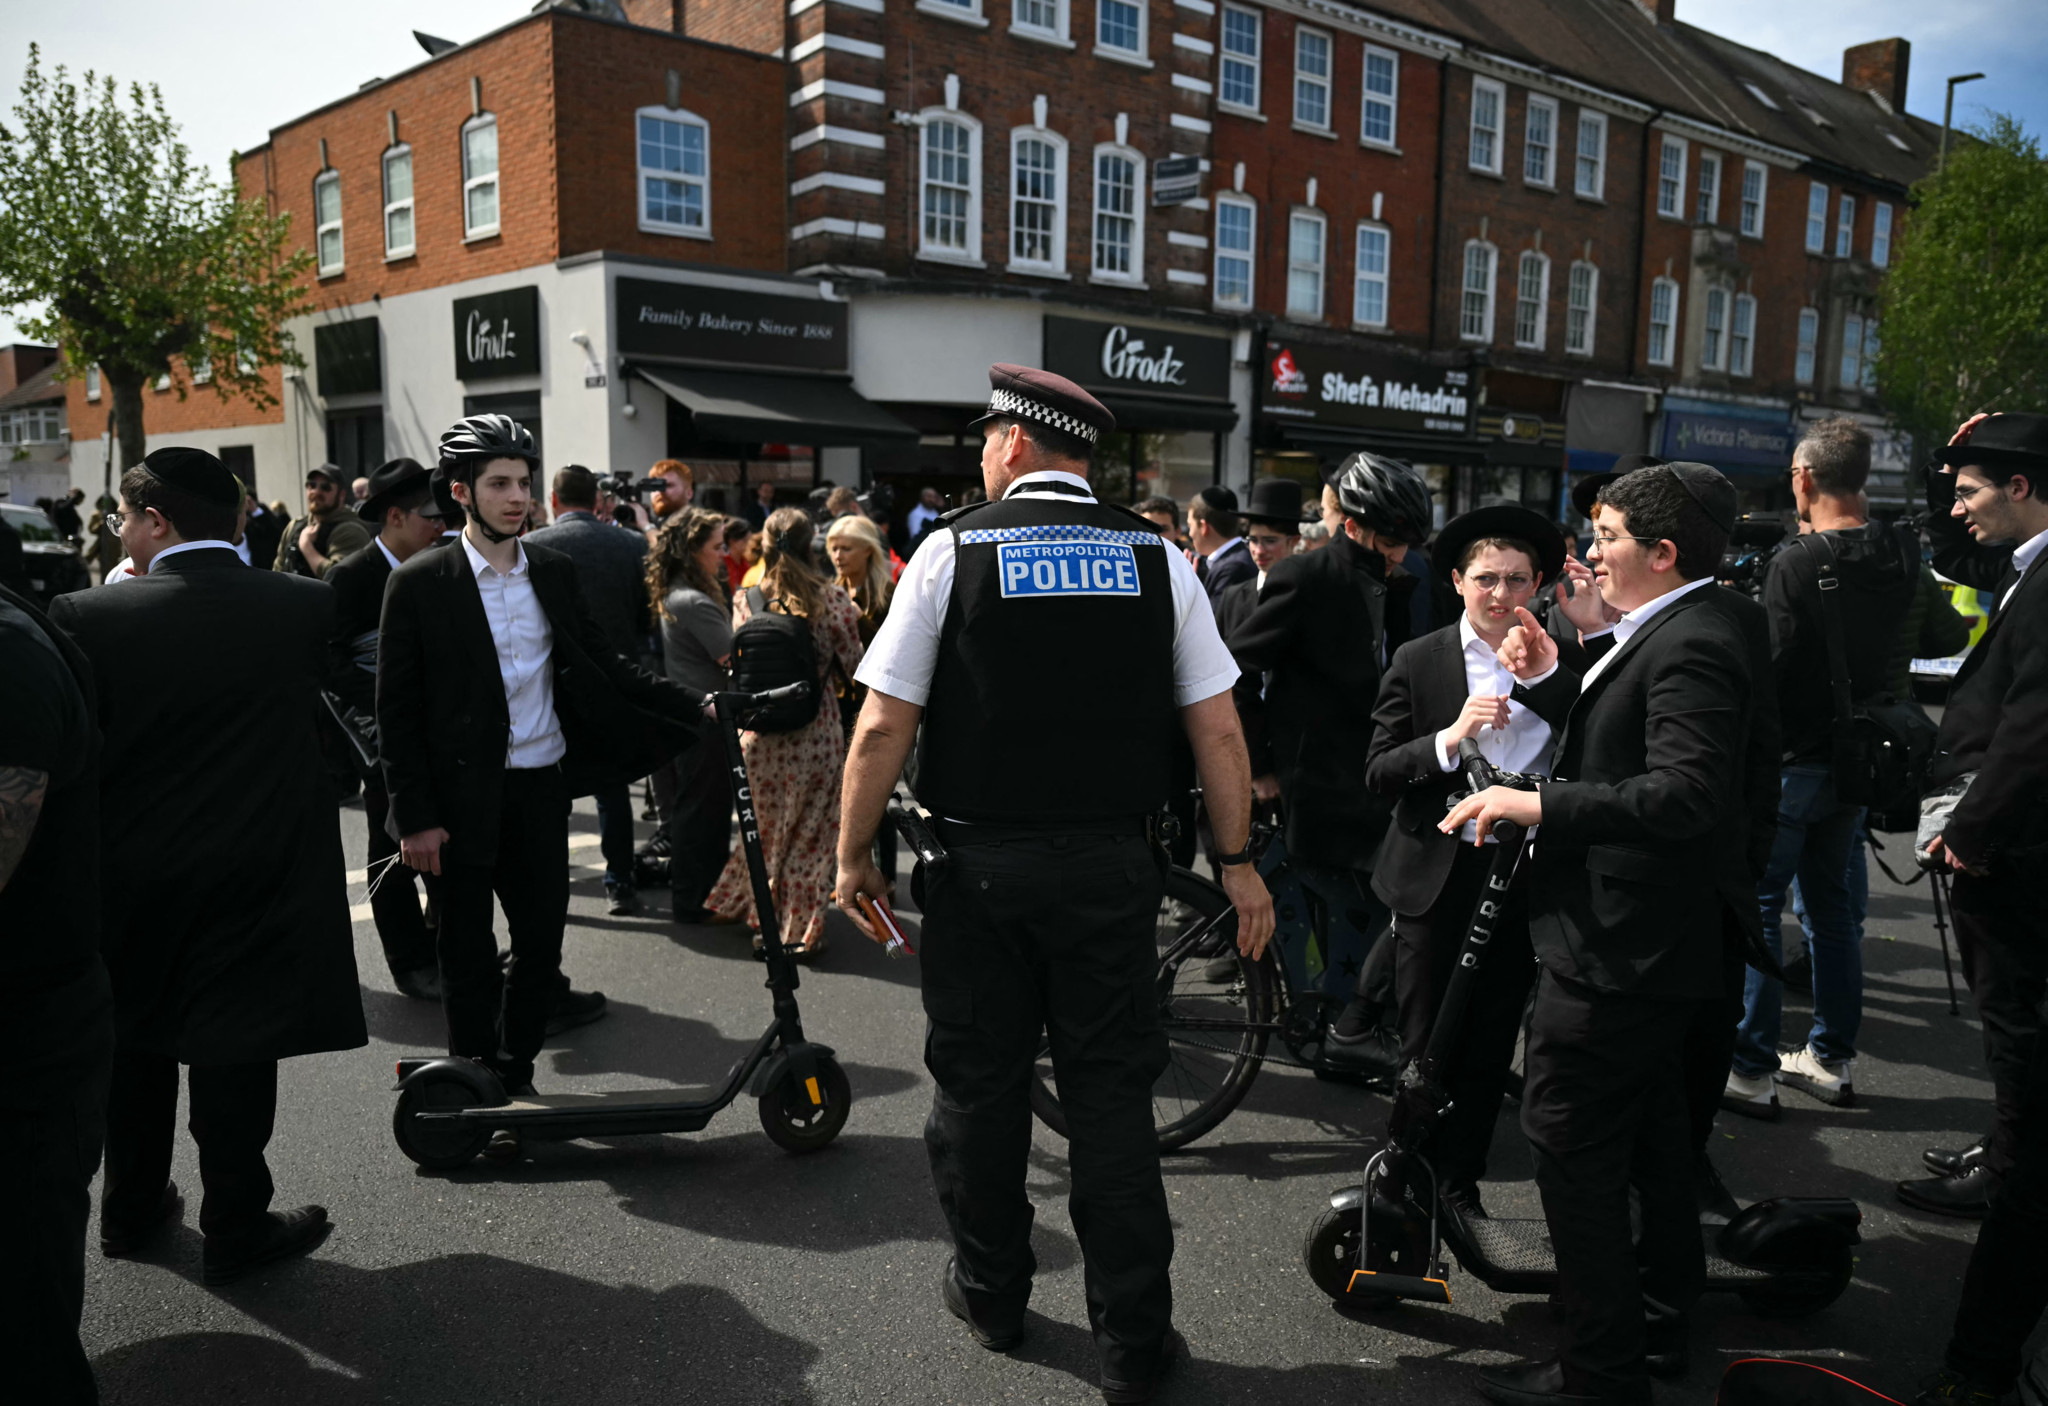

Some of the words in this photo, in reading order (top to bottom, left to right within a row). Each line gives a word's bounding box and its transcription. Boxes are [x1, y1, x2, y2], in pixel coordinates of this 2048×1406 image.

[638, 305, 693, 329] Family
[698, 312, 753, 335] Bakery
[757, 317, 798, 337] Since
[803, 323, 834, 339] 1888
[1102, 325, 1187, 385] Grodz
[1321, 371, 1379, 407] Shefa
[1382, 380, 1467, 417] Mehadrin
[1005, 545, 1130, 559] METROPOLITAN
[1006, 559, 1135, 592] POLICE
[733, 765, 758, 842] PURE
[1461, 874, 1508, 969] PURE
